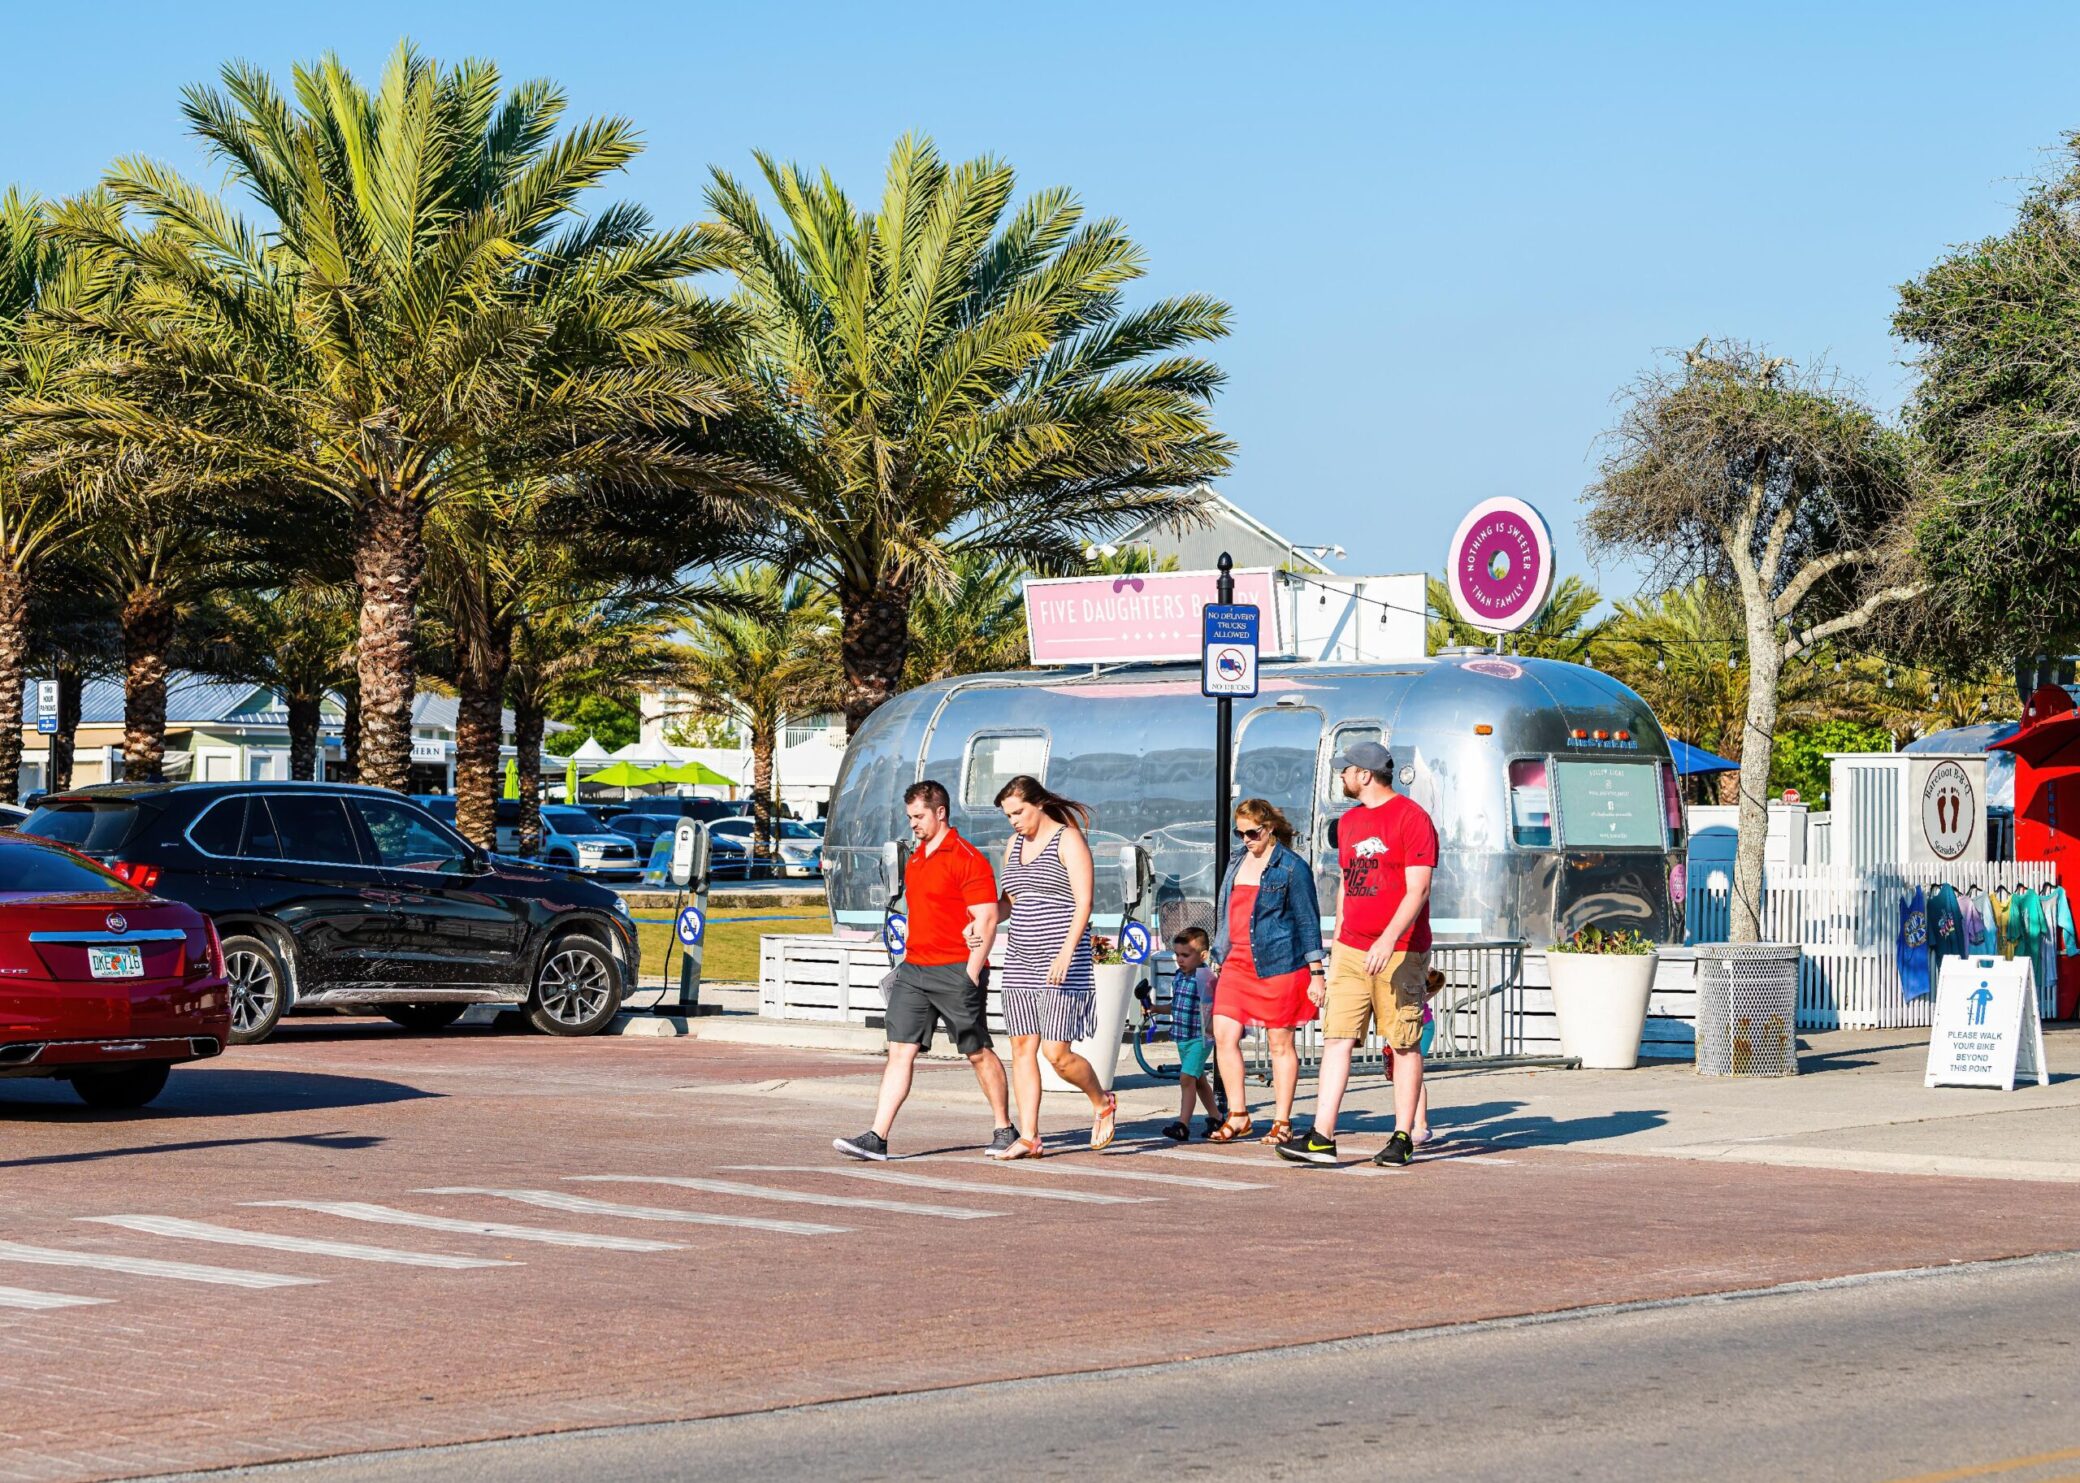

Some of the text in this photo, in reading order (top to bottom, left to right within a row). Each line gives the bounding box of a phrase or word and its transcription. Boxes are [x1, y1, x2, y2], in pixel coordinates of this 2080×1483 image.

[1467, 523, 1531, 571] NOTHING IS SWEETER
[1472, 584, 1524, 608] THAN FAMILY
[1040, 599, 1078, 625] FIVE
[1083, 594, 1185, 624] DAUGHTERS
[1208, 612, 1256, 621] NO DELIVERY
[1217, 622, 1247, 630] TRUCKS
[1213, 631, 1250, 639] ALLOWED
[1224, 683, 1251, 691] TRUCKS
[1925, 768, 1952, 800] Barefoot
[1784, 793, 1799, 802] STOP
[1934, 840, 1965, 855] Seaside, FL
[1343, 868, 1369, 887] PIG
[1947, 1031, 2003, 1040] PLEASE WALK
[1953, 1042, 1996, 1051] YOUR BIKE
[1956, 1053, 1989, 1062] BEYOND
[1950, 1064, 1993, 1073] THIS POINT
